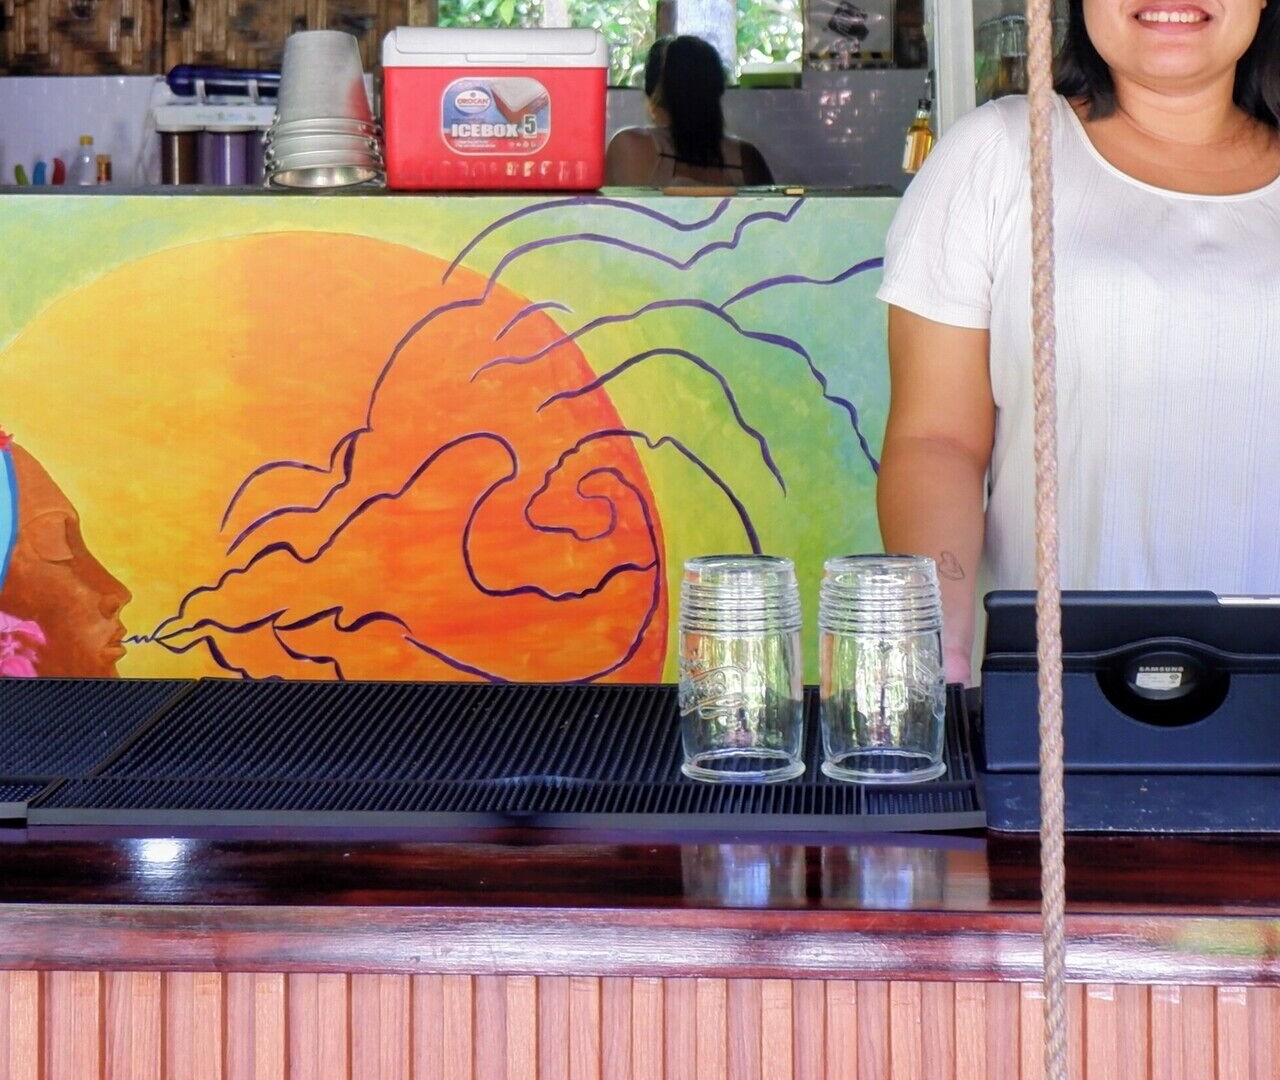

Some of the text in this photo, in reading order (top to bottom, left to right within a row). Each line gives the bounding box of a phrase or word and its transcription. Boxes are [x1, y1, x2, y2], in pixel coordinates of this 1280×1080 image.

[456, 97, 489, 106] OROCAN
[451, 115, 538, 139] ICEBOX 5
[1138, 665, 1185, 673] SAMSUNG
